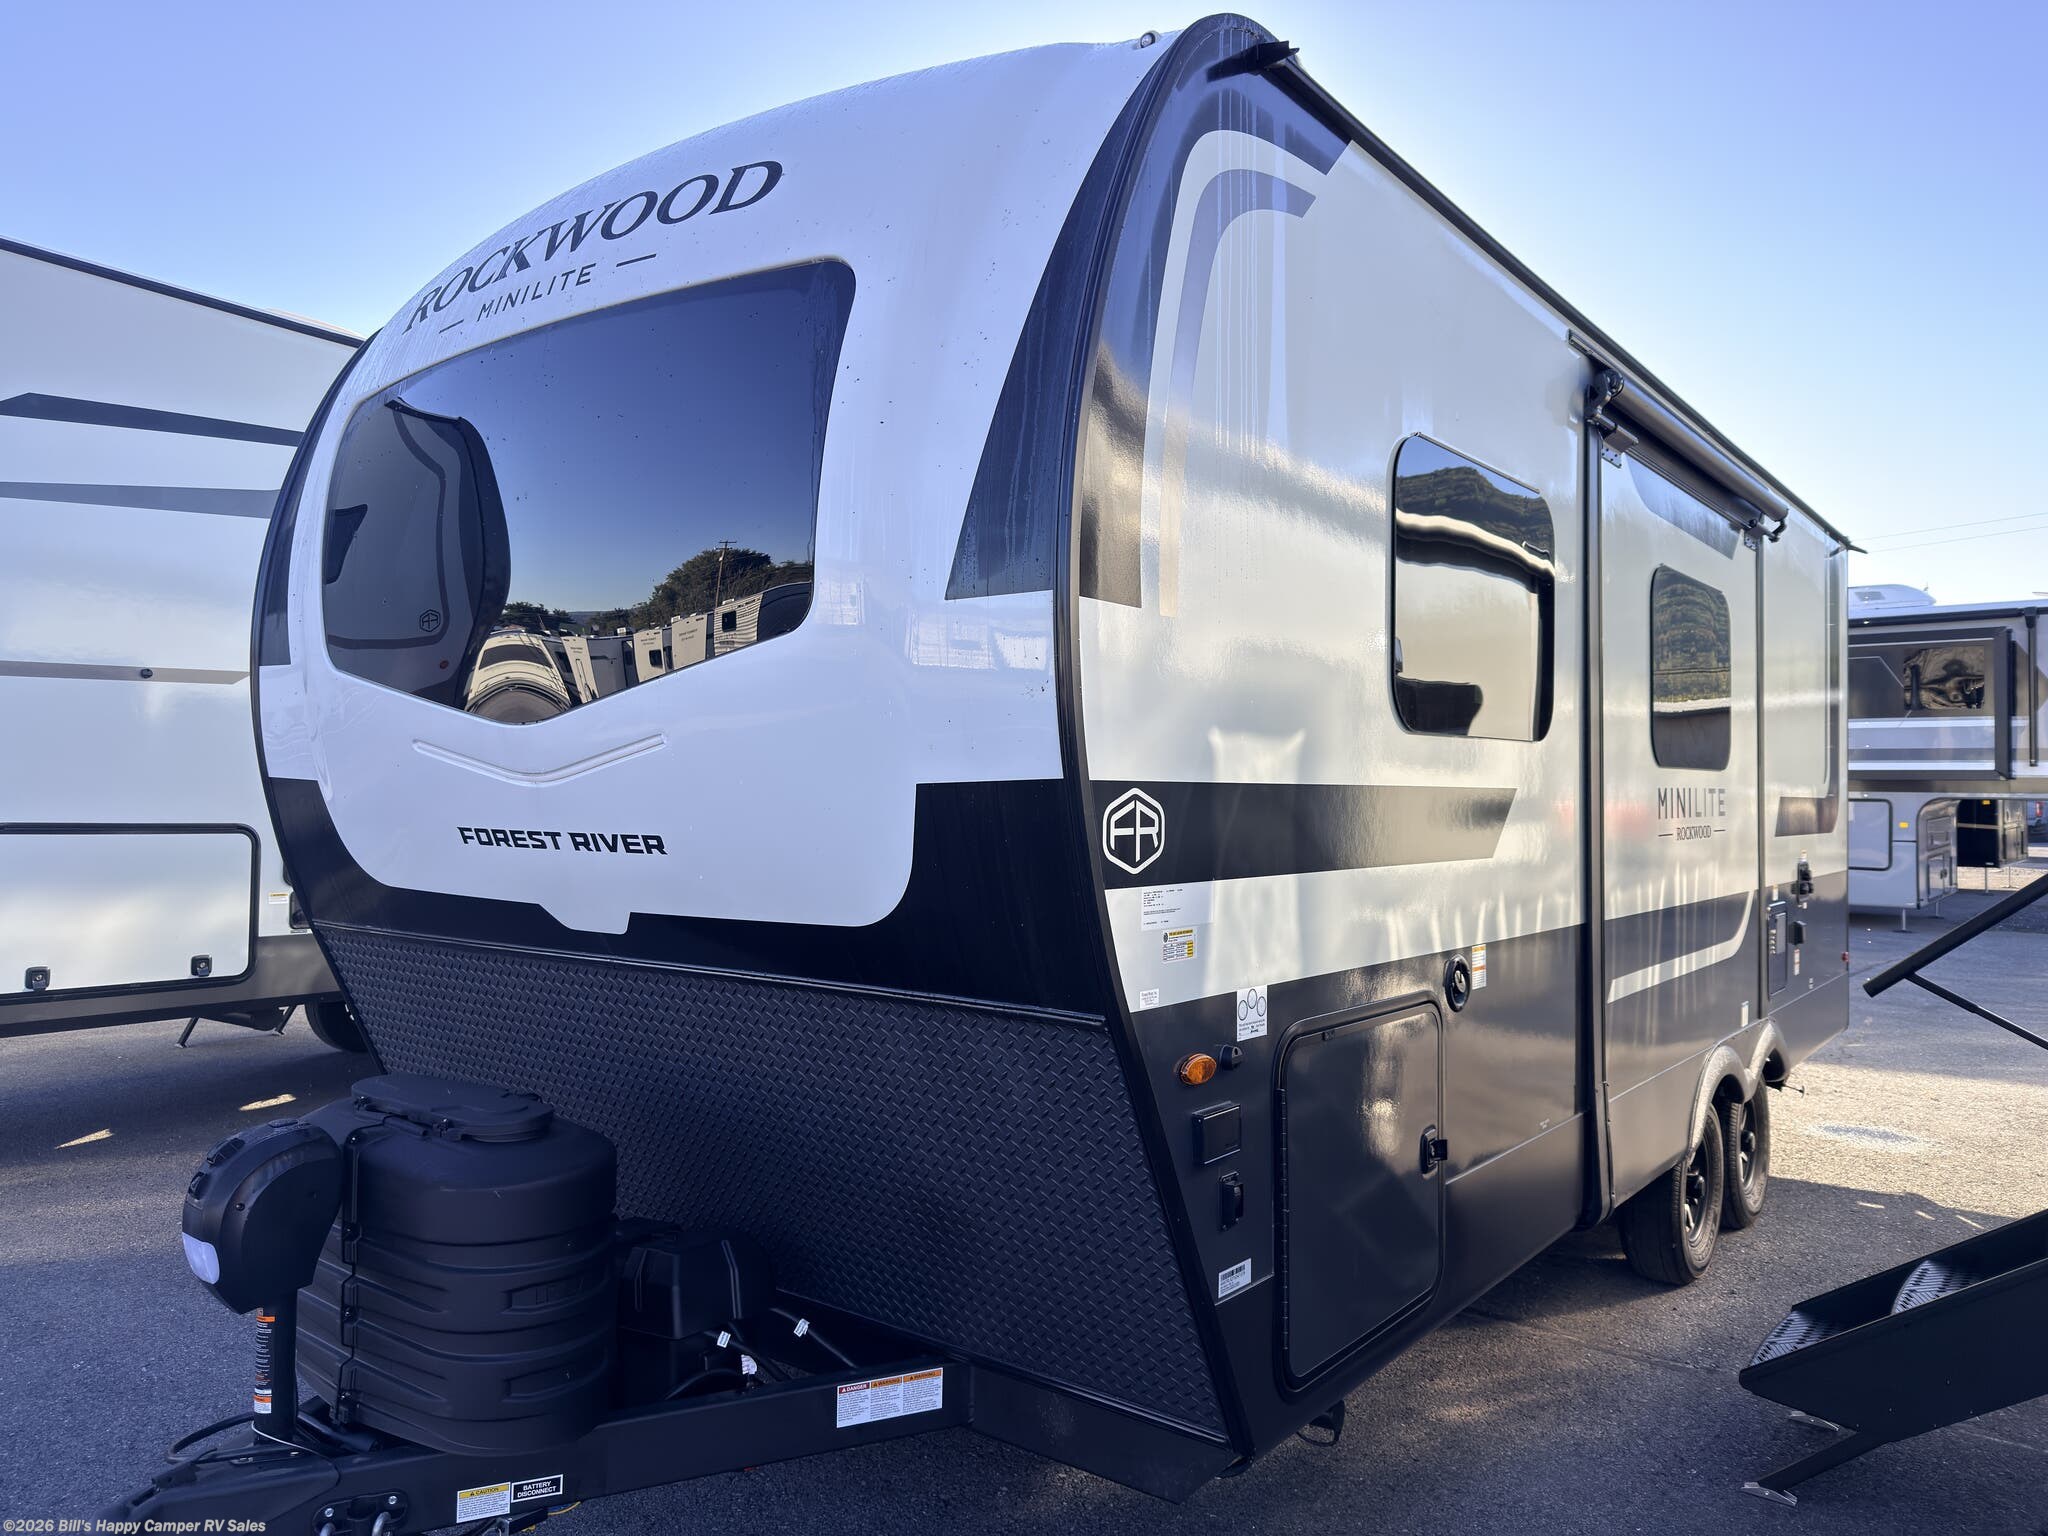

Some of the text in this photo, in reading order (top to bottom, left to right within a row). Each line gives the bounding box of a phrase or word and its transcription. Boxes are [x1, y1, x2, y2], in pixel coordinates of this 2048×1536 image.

[402, 160, 784, 335] ROCKWOOD
[477, 263, 597, 322] MINILITE
[1657, 787, 1726, 819] MINILITE
[456, 826, 668, 856] FOREST RIVER
[1676, 825, 1712, 841] ROCKWOOD
[846, 1383, 868, 1393] DANGER
[476, 1487, 499, 1495] CAUTION
[517, 1485, 557, 1498] DISCONNECT
[523, 1480, 552, 1491] BATTERY
